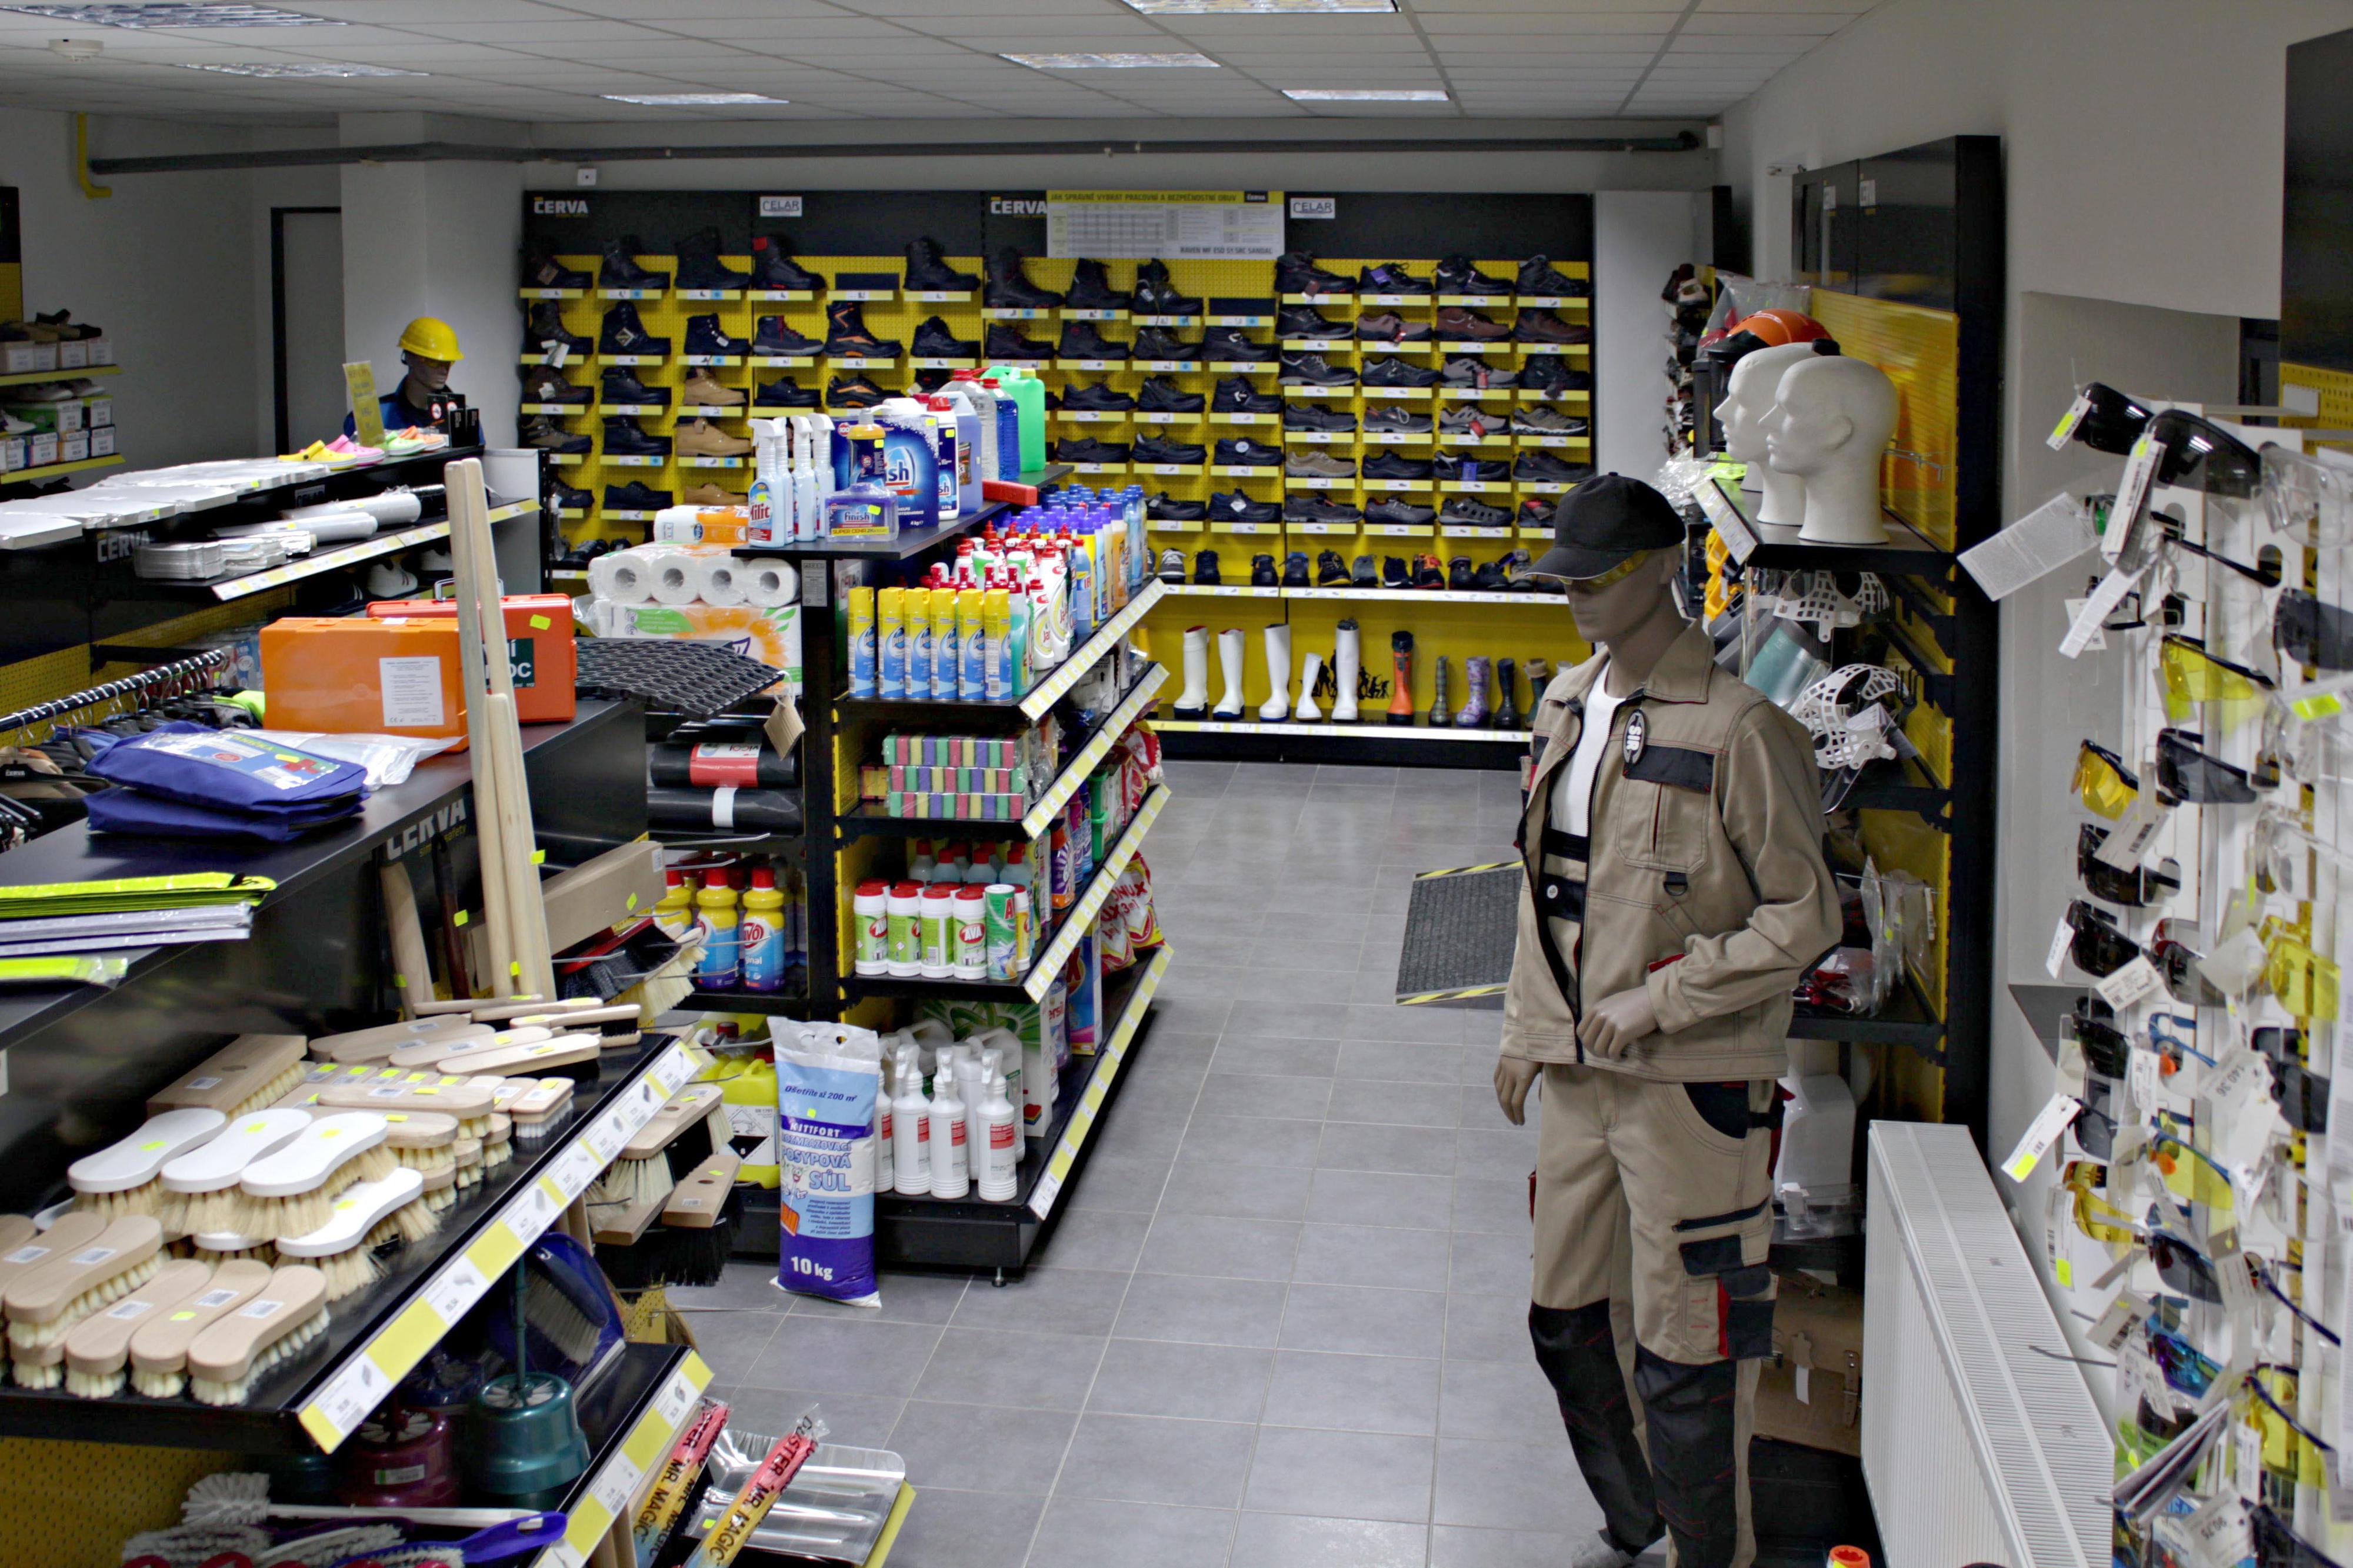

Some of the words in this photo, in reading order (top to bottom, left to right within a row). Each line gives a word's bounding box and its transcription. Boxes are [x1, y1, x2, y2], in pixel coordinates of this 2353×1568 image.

[762, 200, 799, 212] CELAR
[1294, 202, 1332, 213] CELAR
[1626, 725, 1642, 750] SIR
[964, 925, 983, 941] AVA
[785, 1086, 818, 1097] Ošetříte
[827, 1092, 844, 1101] 200
[789, 1123, 841, 1138] KITTFORT
[809, 1169, 852, 1192] SŮL
[791, 1255, 812, 1275] 10
[814, 1262, 834, 1281] kg
